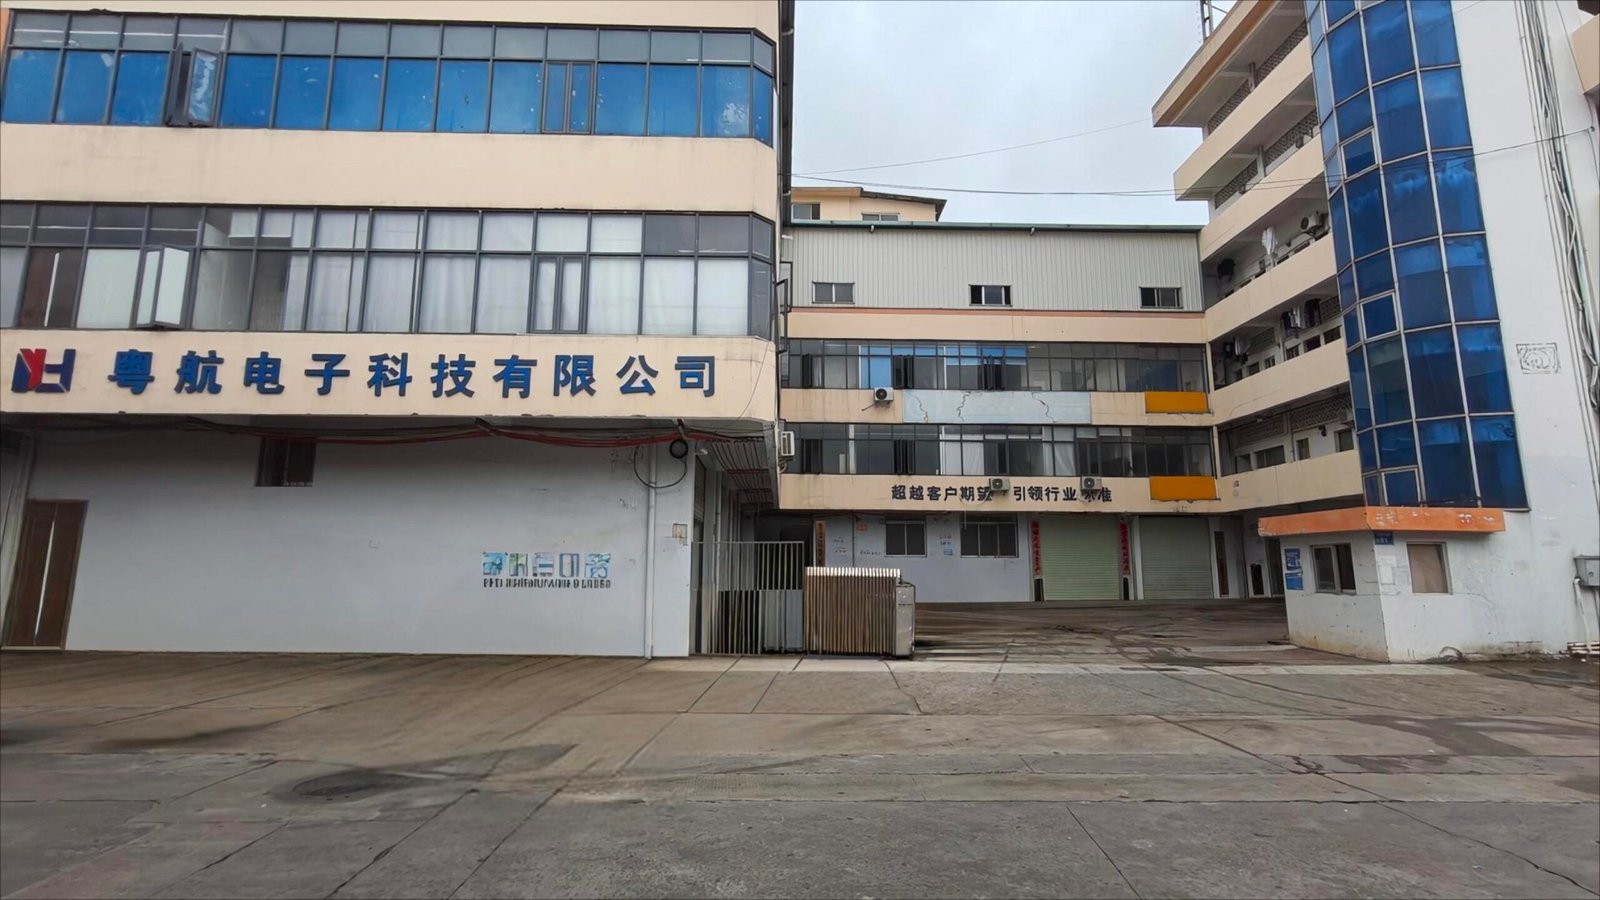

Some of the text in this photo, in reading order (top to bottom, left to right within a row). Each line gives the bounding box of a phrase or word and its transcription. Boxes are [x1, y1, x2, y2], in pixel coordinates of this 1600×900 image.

[108, 349, 715, 398] 粤航电子科技有限公司
